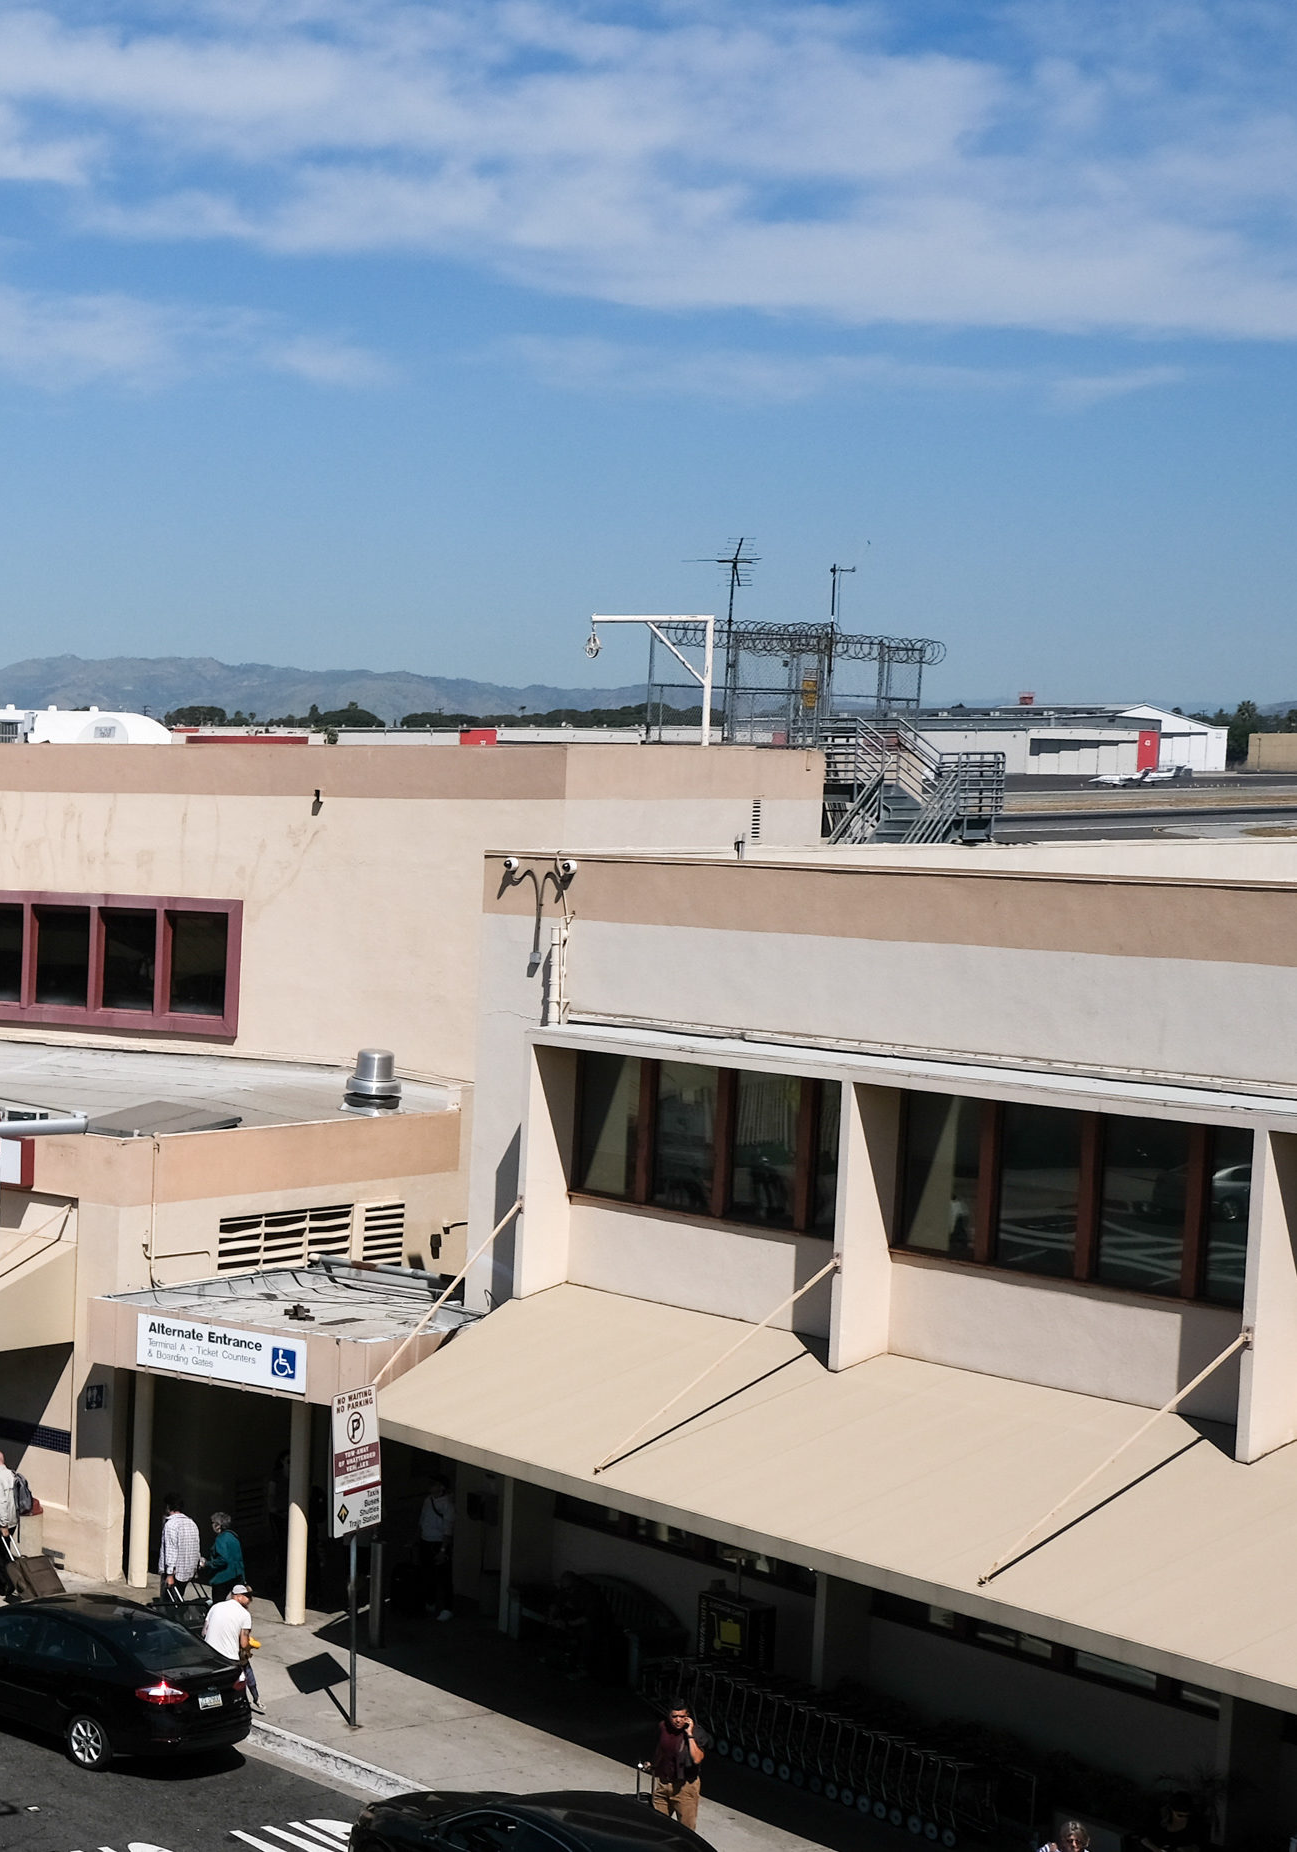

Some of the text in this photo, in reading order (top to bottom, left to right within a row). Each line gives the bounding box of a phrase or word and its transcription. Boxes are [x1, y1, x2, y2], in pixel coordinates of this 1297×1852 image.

[148, 1322, 263, 1352] Alternate Entrance
[147, 1349, 214, 1368] & Boarding Gates
[148, 1338, 177, 1351] Terminal
[196, 1345, 219, 1358] Ticket
[221, 1350, 256, 1365] Counters
[336, 1397, 374, 1414] NO PARKING
[337, 1389, 373, 1406] NO WAITING
[367, 1488, 380, 1498] Taxis
[364, 1498, 380, 1508] Buses
[359, 1506, 380, 1518] Shuttles
[362, 1513, 380, 1525] Station
